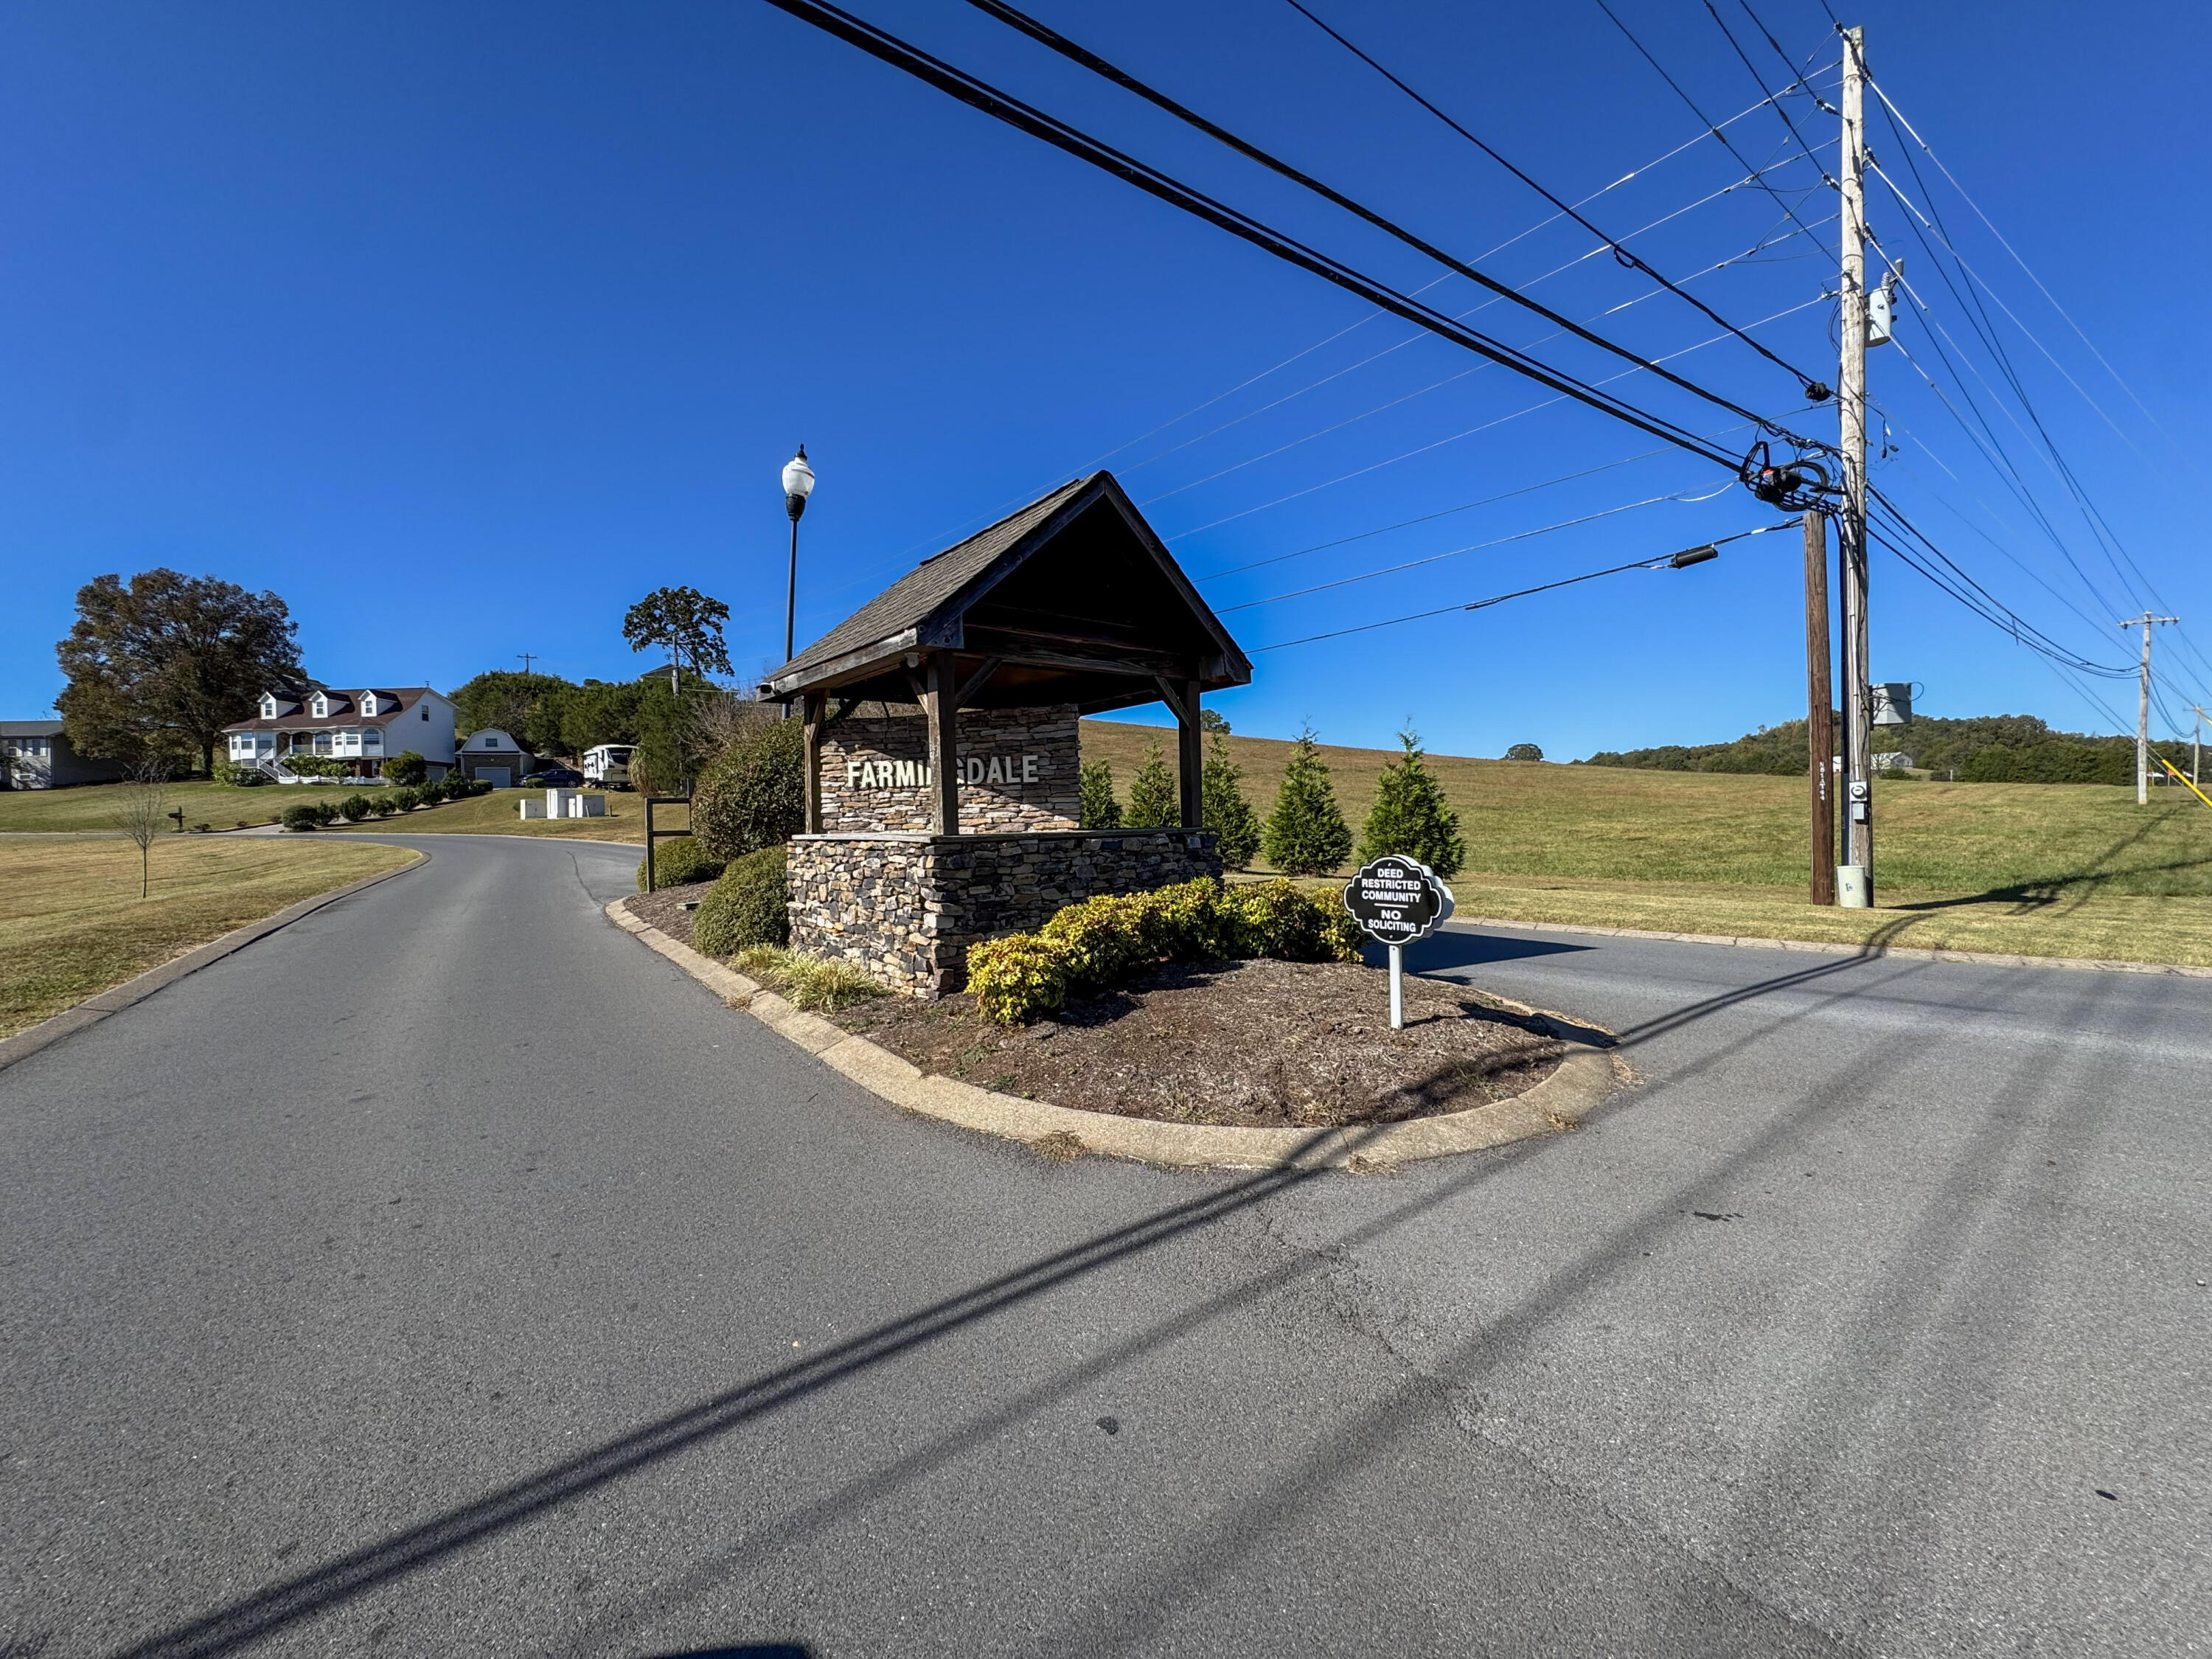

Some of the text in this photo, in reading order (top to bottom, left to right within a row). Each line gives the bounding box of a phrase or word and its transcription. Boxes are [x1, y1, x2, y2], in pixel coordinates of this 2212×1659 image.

[1377, 868, 1404, 878] DEED
[1361, 878, 1421, 891] RESTRICTED
[1361, 891, 1422, 903] COMMUNITY
[1381, 909, 1402, 920] NO
[1368, 919, 1416, 933] SOLICITING
